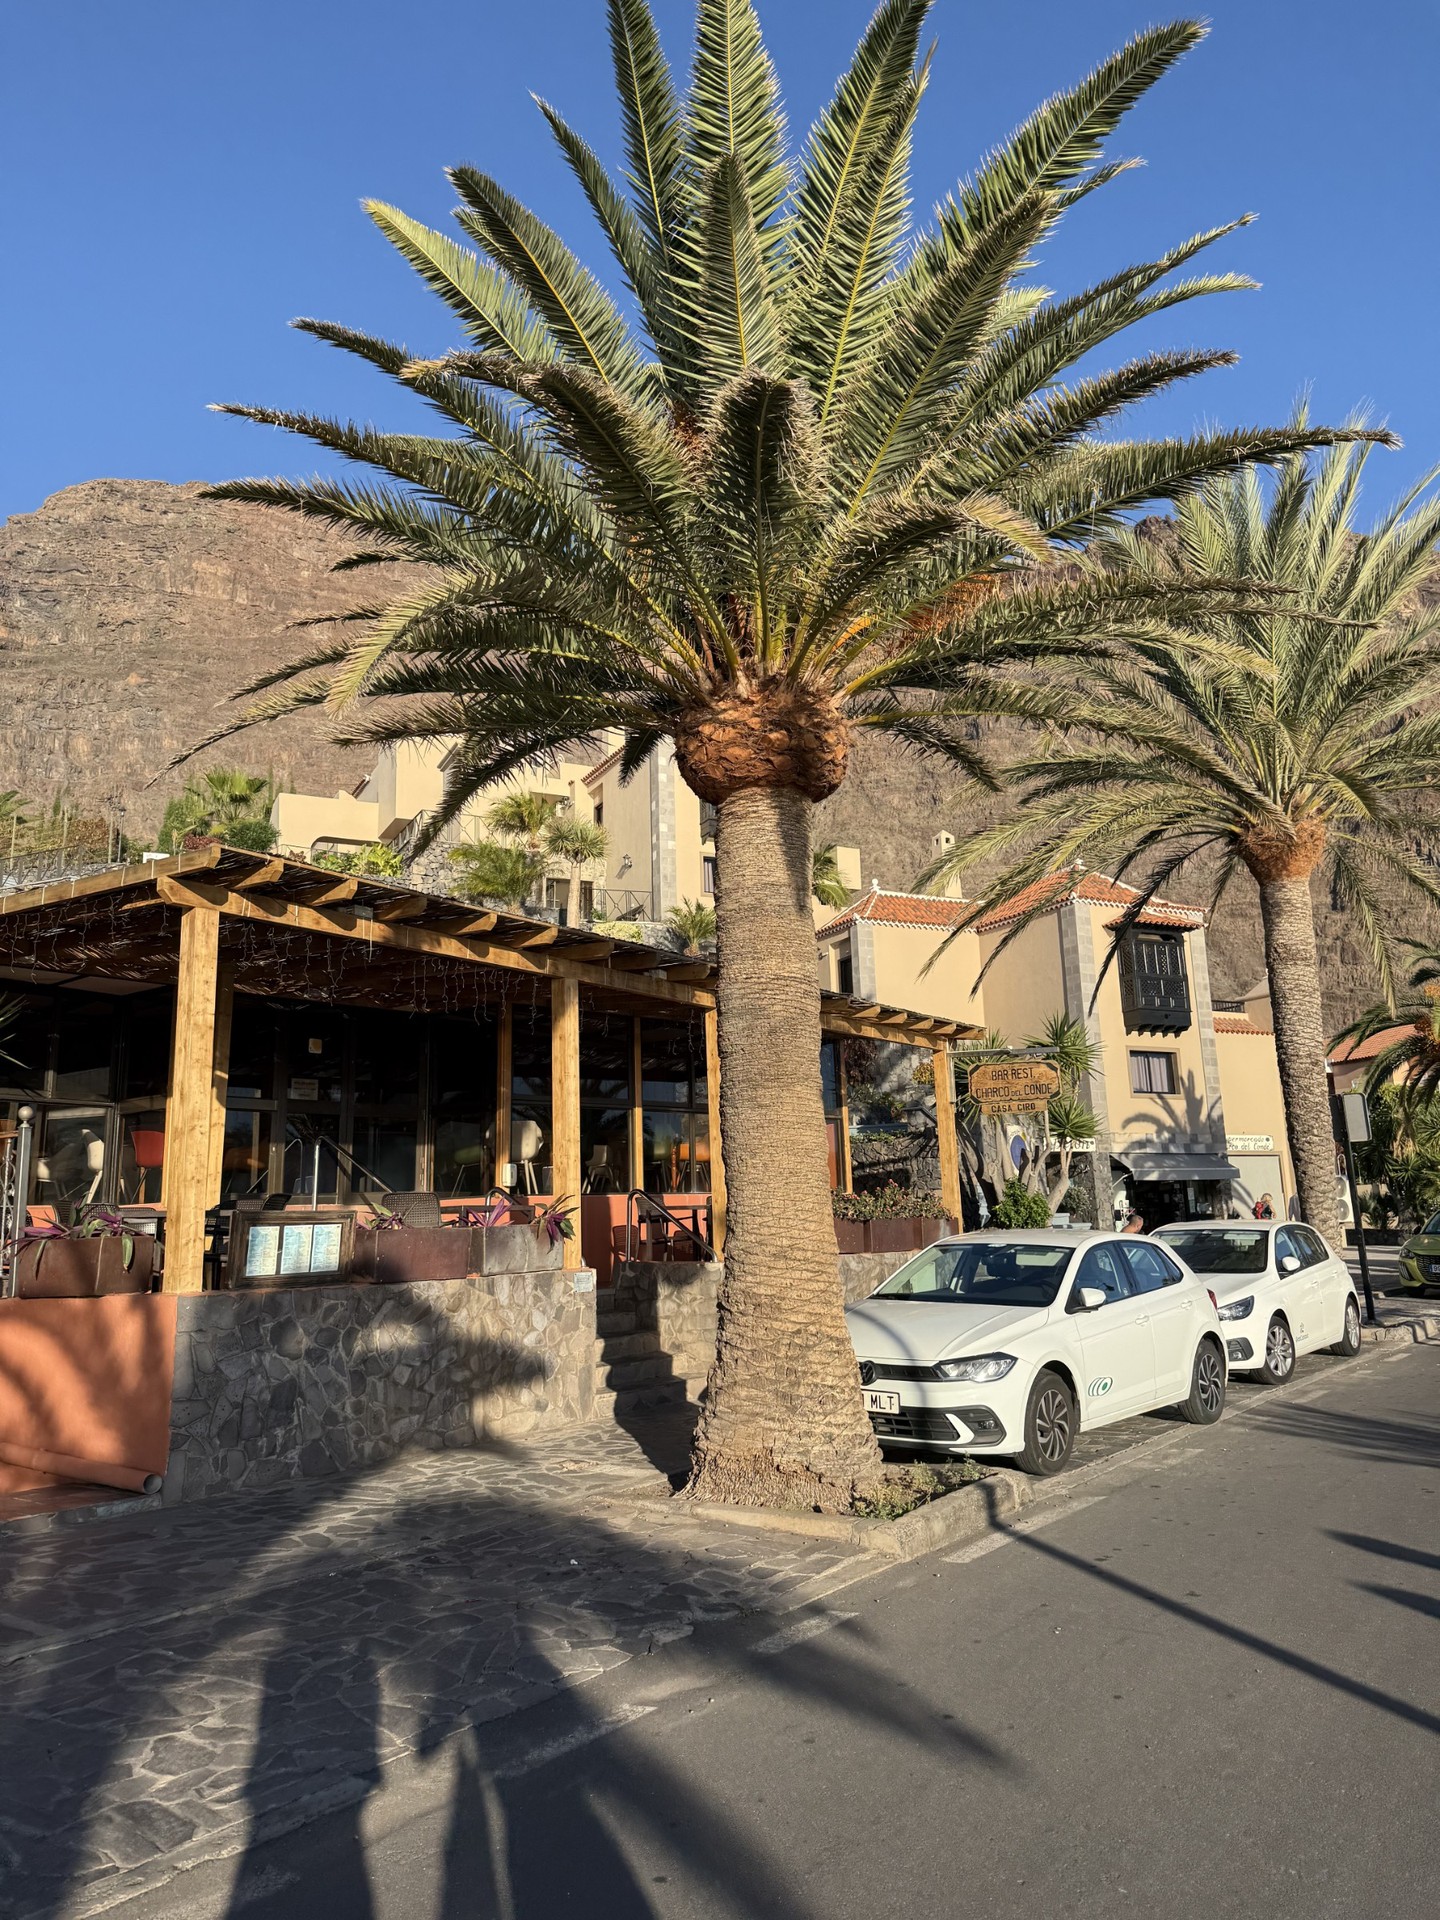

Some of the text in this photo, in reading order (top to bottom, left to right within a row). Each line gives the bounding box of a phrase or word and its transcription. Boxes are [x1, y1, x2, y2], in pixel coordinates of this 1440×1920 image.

[991, 1070, 1009, 1081] BAR
[976, 1086, 1010, 1099] CHARCO
[1024, 1083, 1053, 1096] CONDE
[991, 1102, 1036, 1113] CASA CIRO
[870, 1394, 894, 1410] MLT
